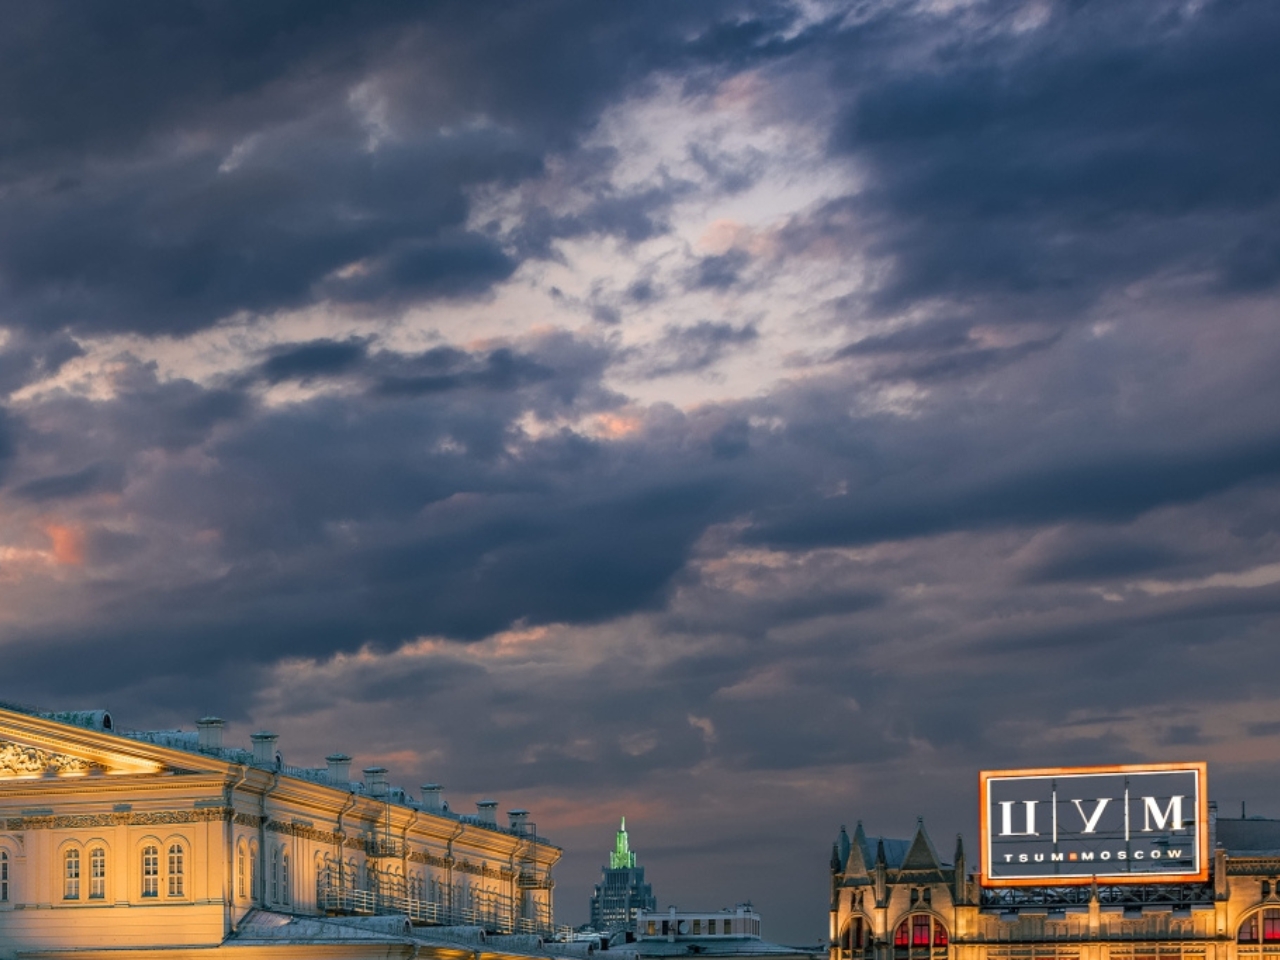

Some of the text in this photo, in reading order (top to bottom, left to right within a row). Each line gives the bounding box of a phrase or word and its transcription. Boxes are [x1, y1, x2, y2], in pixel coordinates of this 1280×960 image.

[998, 795, 1186, 836] ЦУМ
[1004, 849, 1182, 862] TSUM MOSCOW
